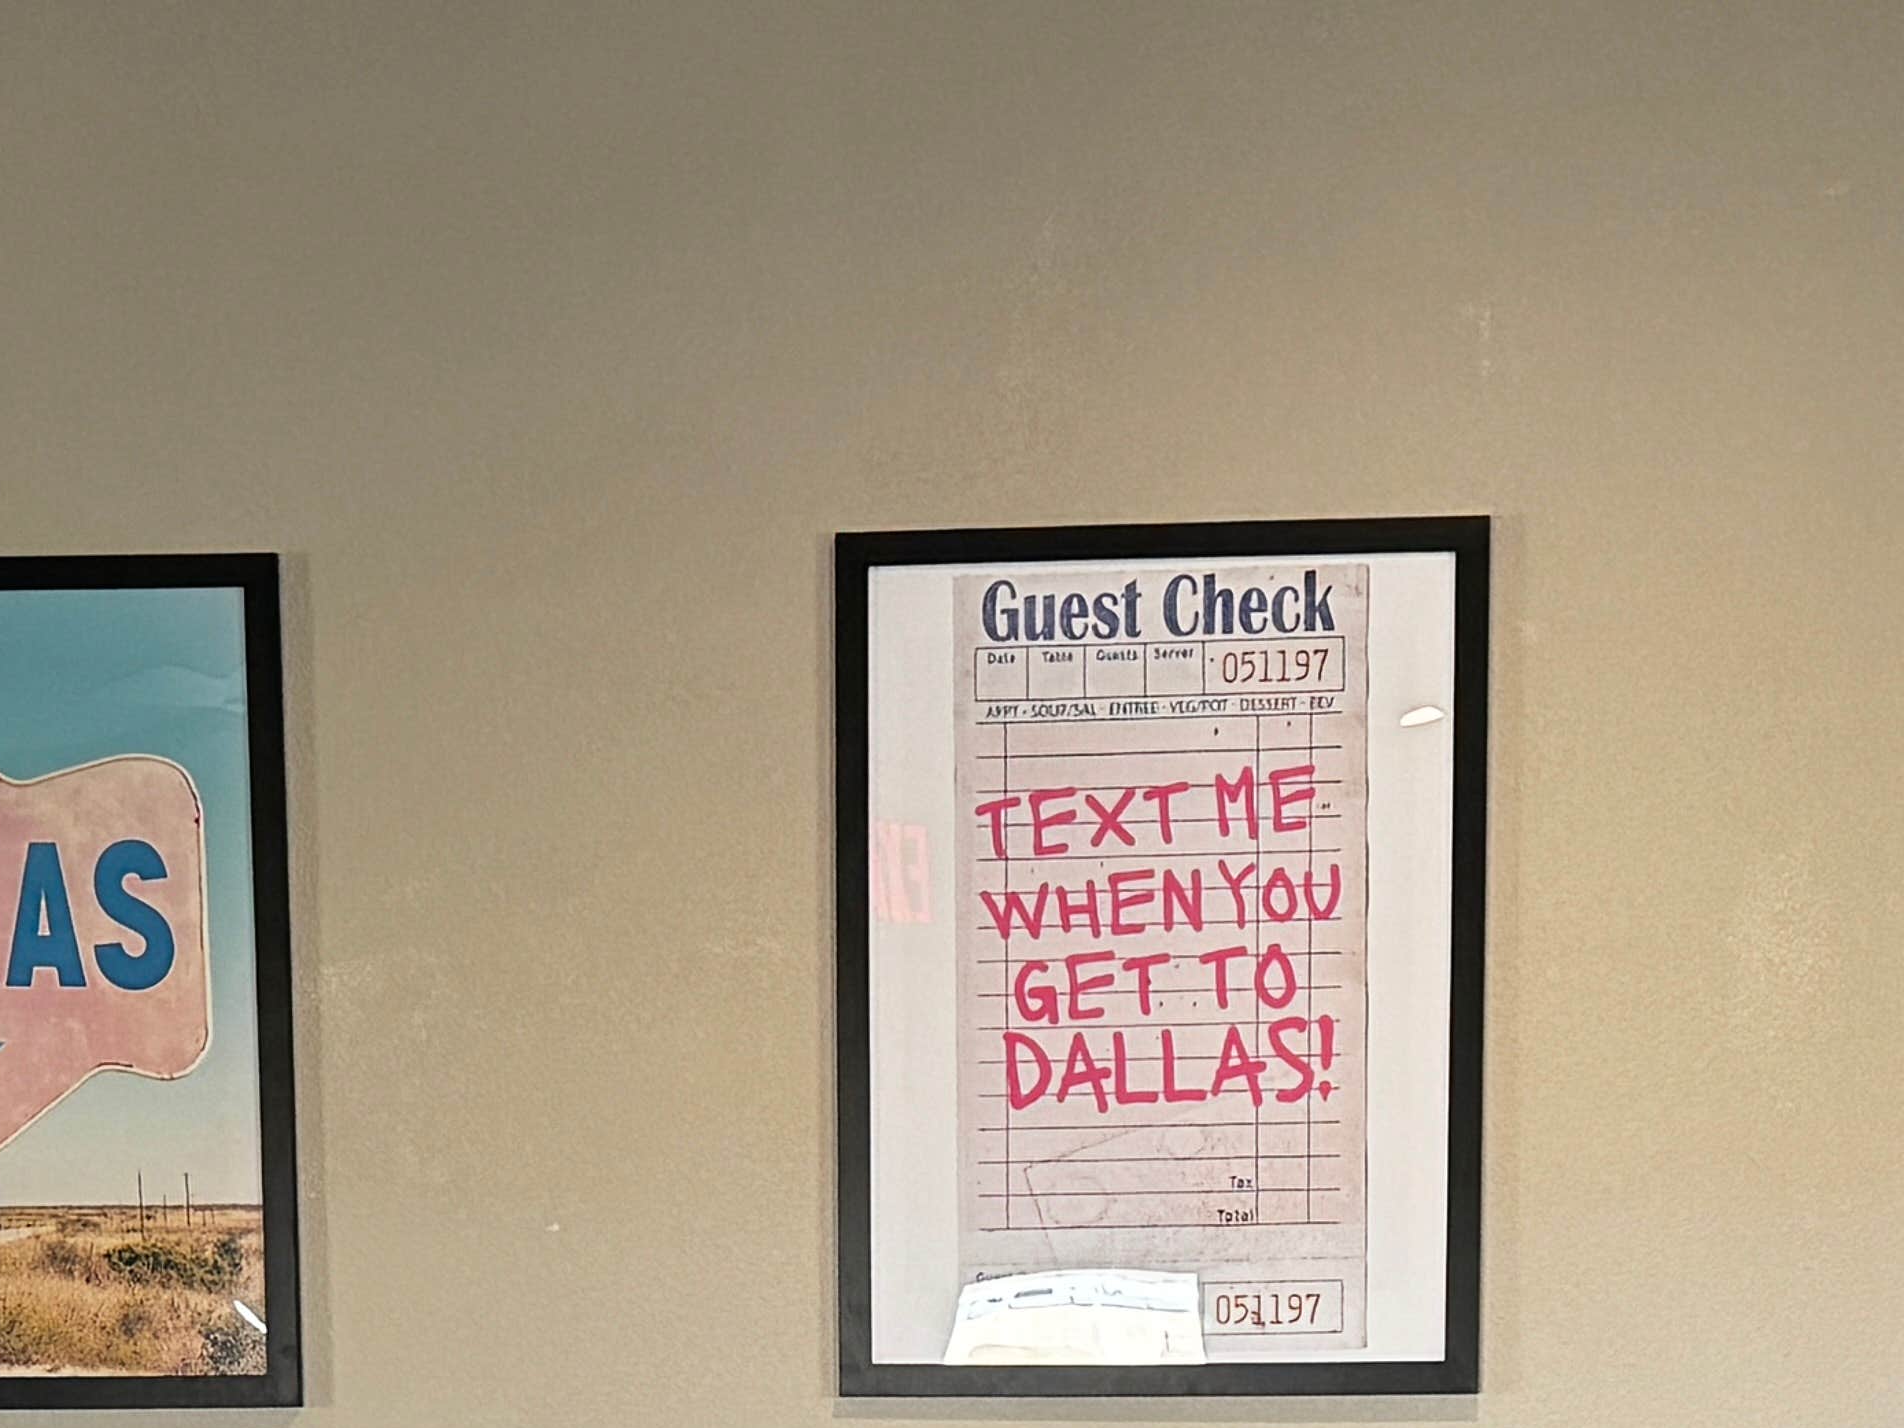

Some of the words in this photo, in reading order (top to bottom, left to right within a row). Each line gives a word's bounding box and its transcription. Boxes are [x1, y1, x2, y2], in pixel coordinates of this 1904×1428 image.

[981, 577, 1143, 643] Guest
[1162, 569, 1335, 636] Check
[1221, 648, 1330, 683] 051197
[975, 781, 1190, 858] TEXT
[1215, 765, 1316, 840] ME
[980, 868, 1204, 940] WHEN
[1218, 859, 1341, 929] YOU
[1014, 950, 1172, 1024] GET
[1199, 943, 1297, 1010] TO
[1003, 1014, 1335, 1114] DALLAS!
[1216, 1207, 1255, 1224] Total
[1214, 1292, 1322, 1329] 051197
